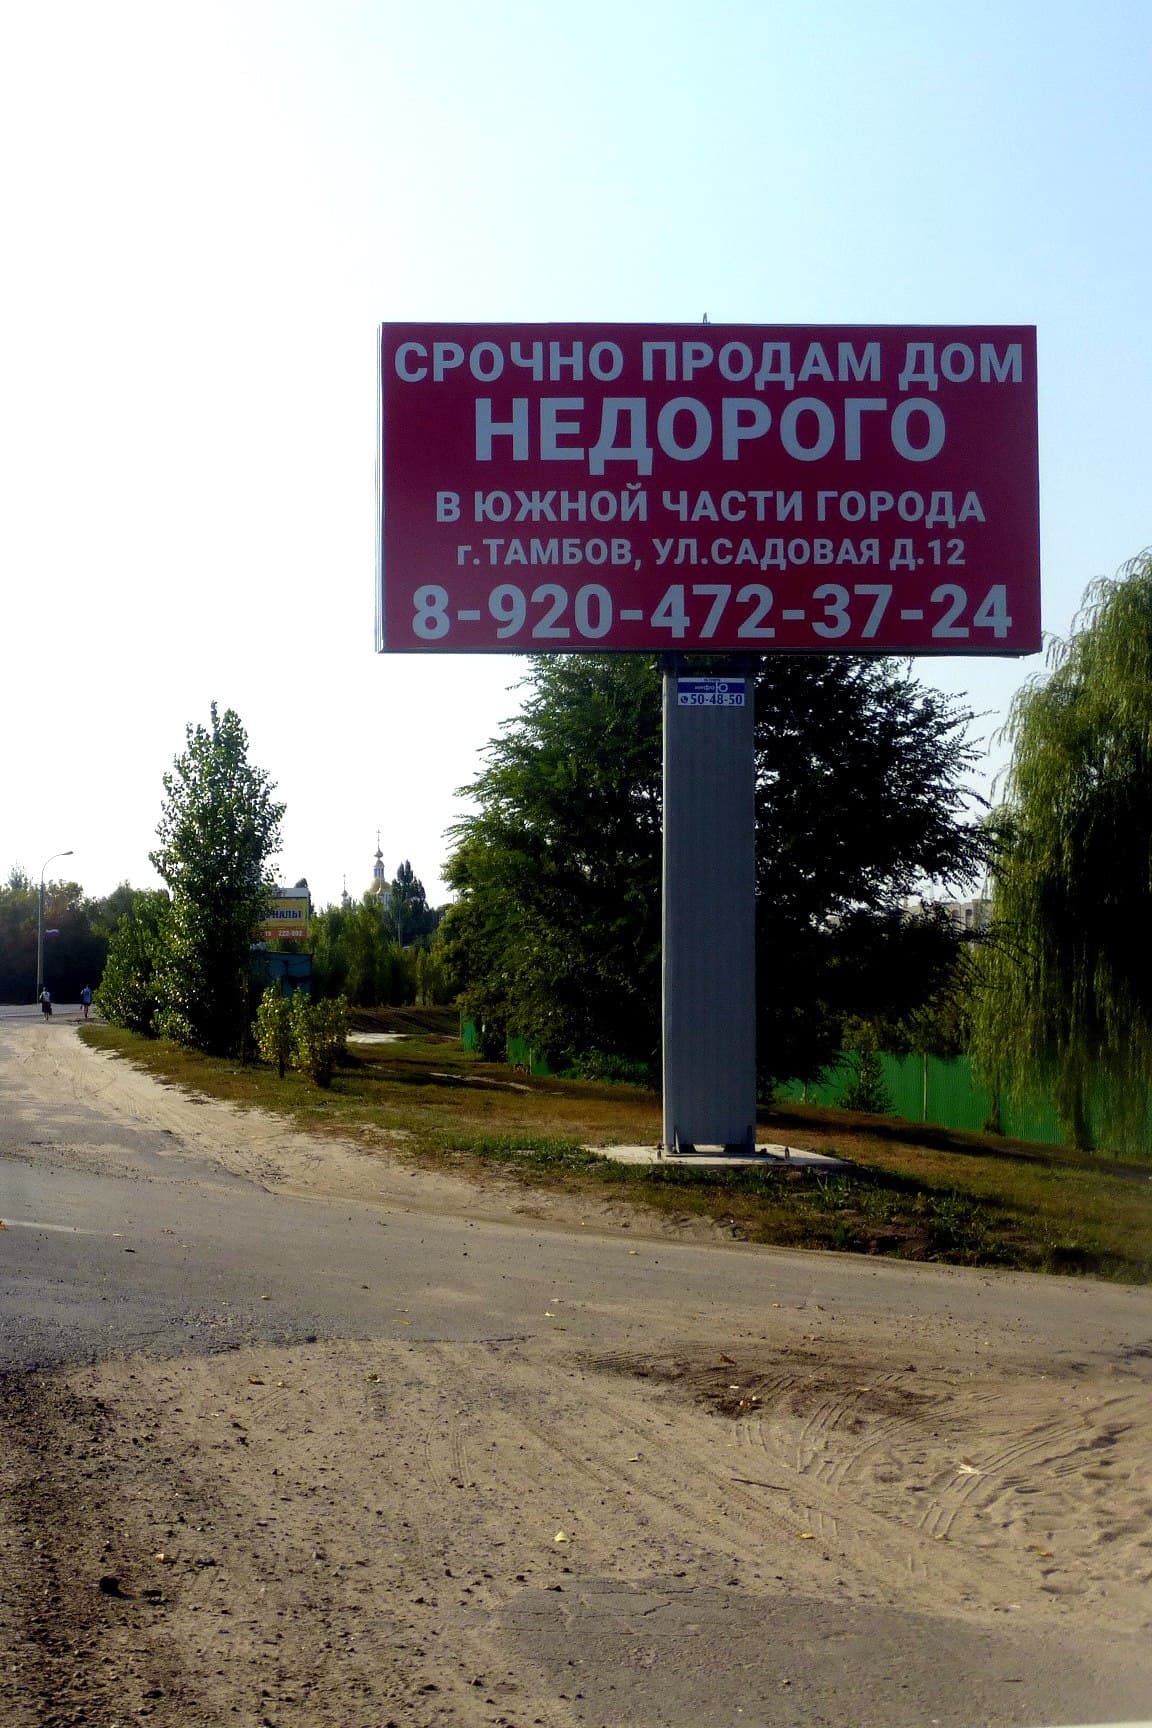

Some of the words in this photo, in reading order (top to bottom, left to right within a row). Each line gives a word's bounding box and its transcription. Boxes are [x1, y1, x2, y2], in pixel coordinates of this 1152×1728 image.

[395, 341, 624, 383] СРОЧНО
[642, 341, 881, 391] ПРОДАМ
[898, 342, 1023, 391] ДОМ
[475, 396, 946, 476] НЕДОРОГО
[436, 491, 461, 522] В
[474, 483, 647, 522] ЮЖНОЙ
[662, 490, 803, 522] ЧАСТИ
[817, 490, 986, 528] ГОРОДА
[457, 538, 641, 571] г.ТАМБОВ,
[652, 538, 880, 571] УЛ.САДОВАЯ
[889, 538, 965, 571] Д.12
[412, 583, 1013, 639] 8-920-472-37-24
[690, 693, 743, 705] 50-48-50
